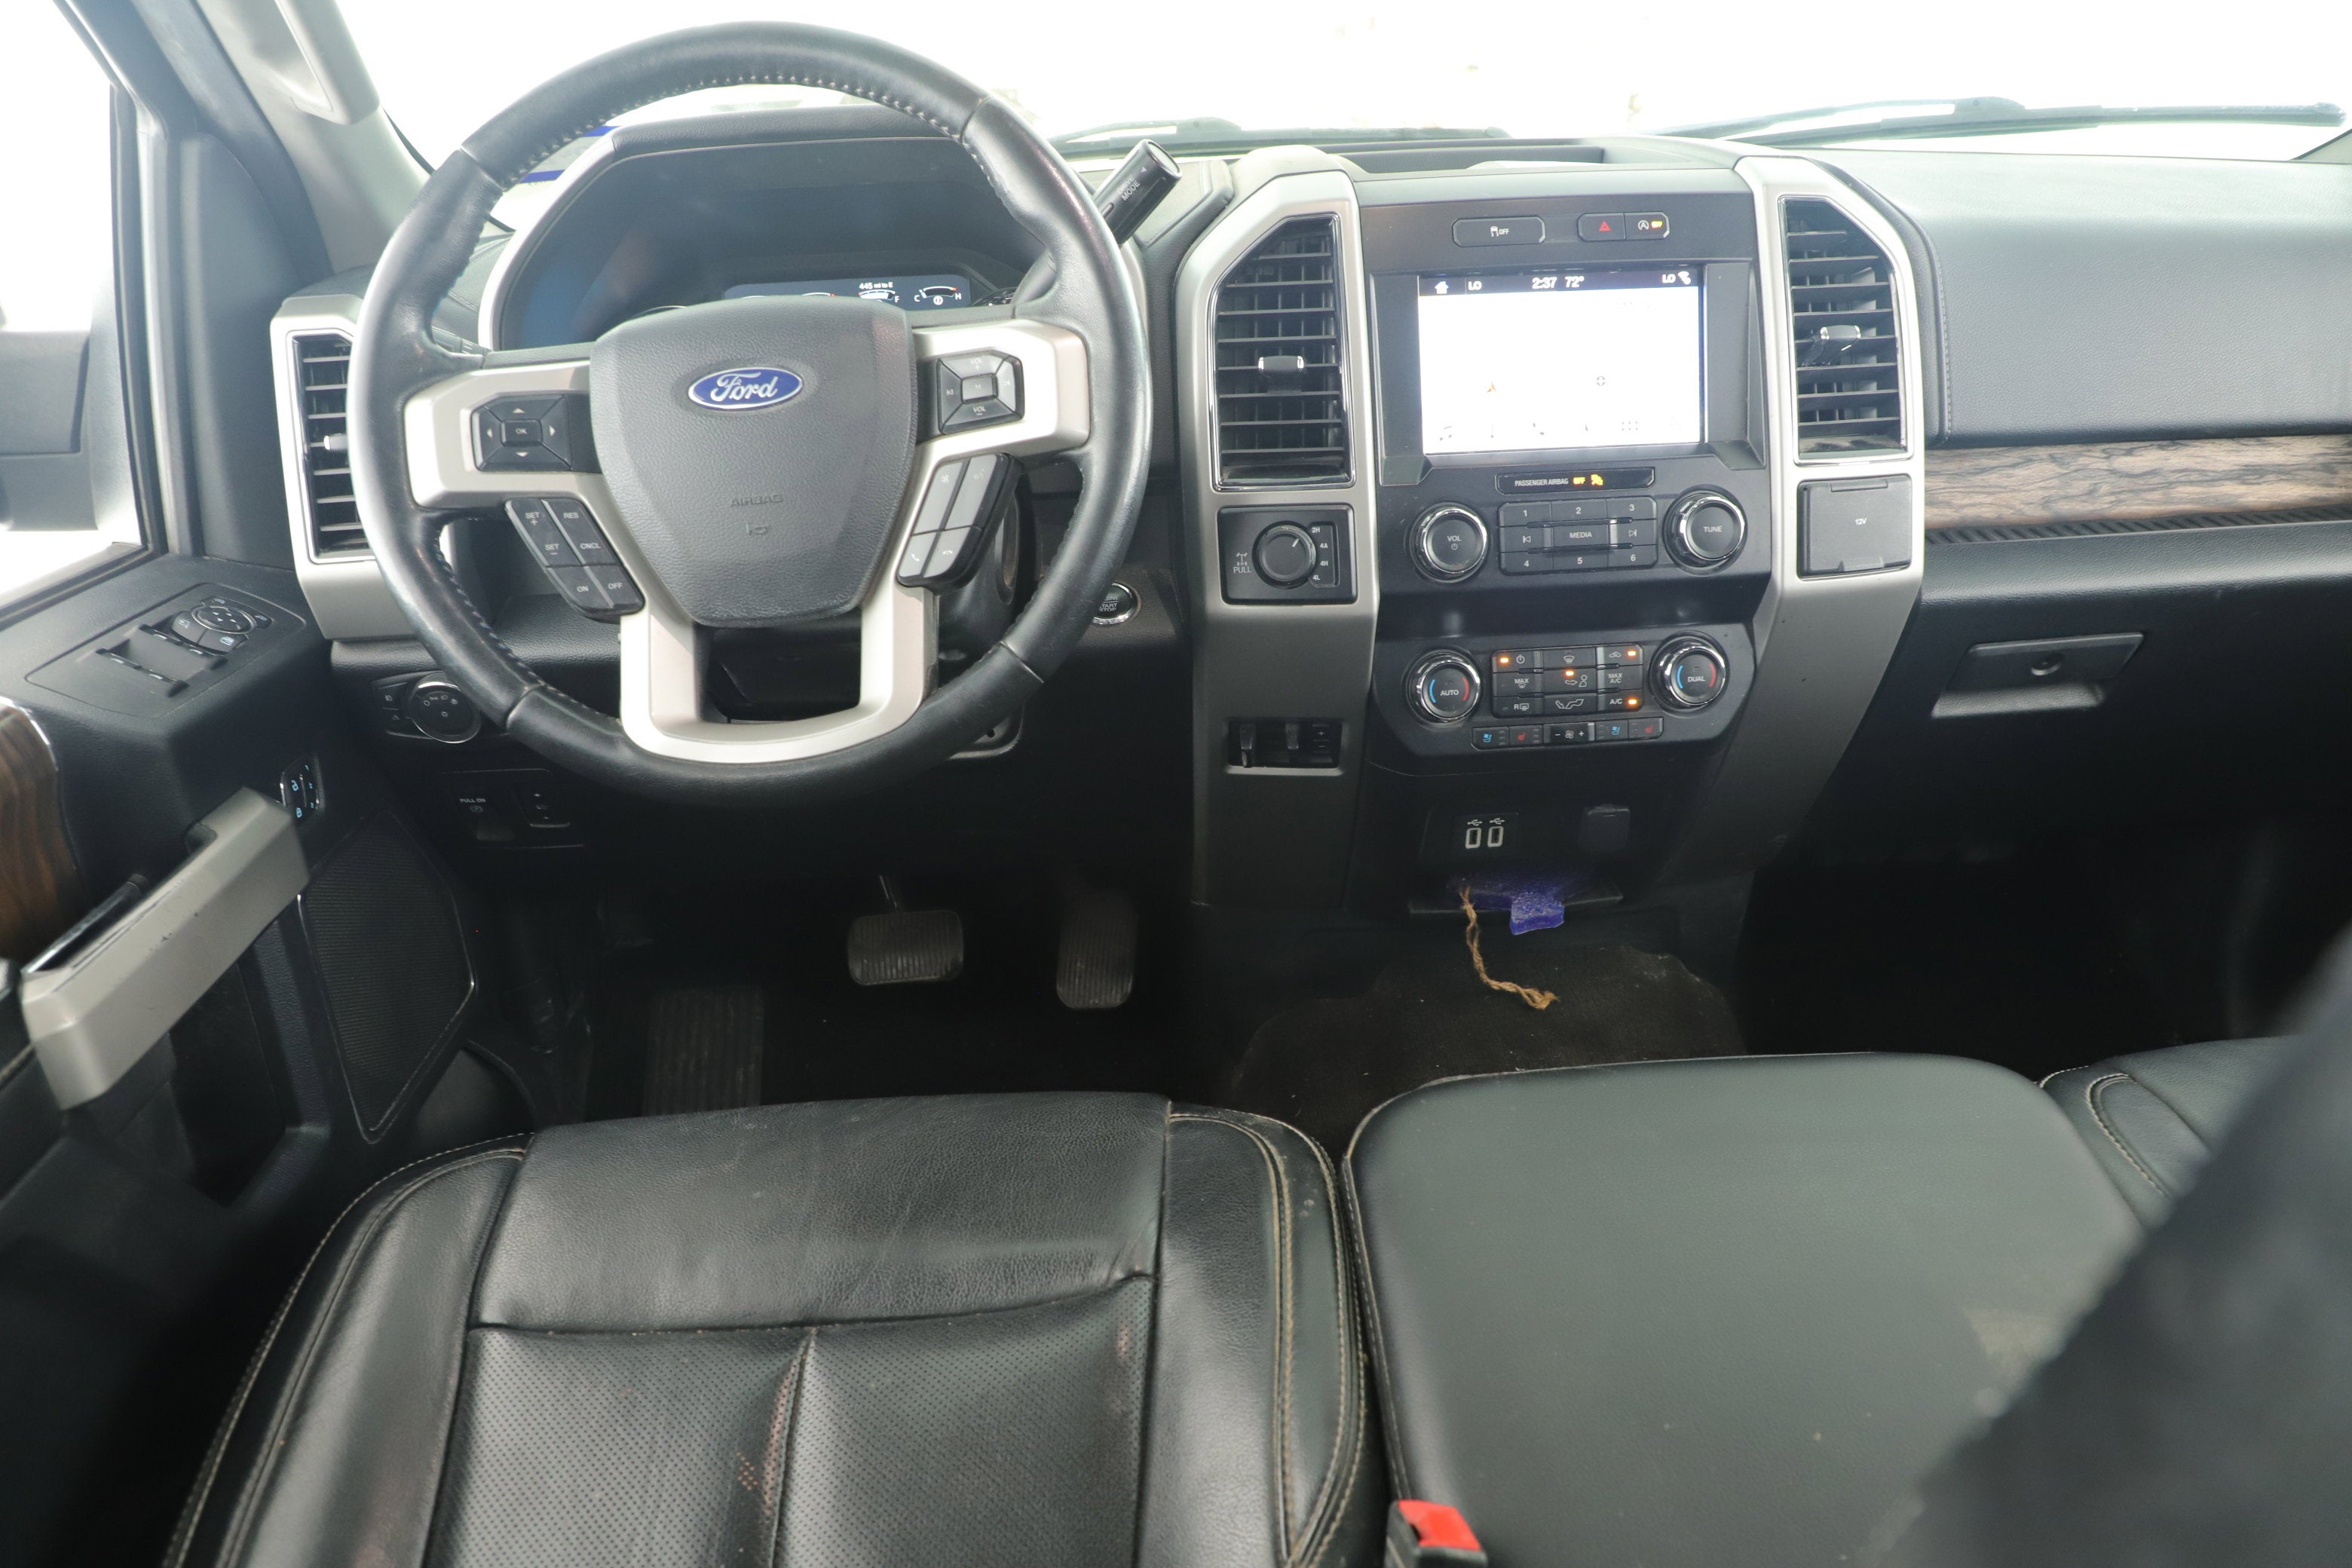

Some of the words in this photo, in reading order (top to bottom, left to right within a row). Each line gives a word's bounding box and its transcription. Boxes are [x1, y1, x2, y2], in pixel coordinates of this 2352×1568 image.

[1121, 179, 1141, 201] MODE
[1532, 277, 1557, 289] 2:37
[1565, 275, 1585, 288] 72°
[1662, 274, 1676, 283] LO
[1468, 280, 1482, 291] LO
[710, 372, 779, 402] Ford
[1514, 479, 1548, 487] PASSENGER
[1548, 477, 1569, 485] AIRBAG
[1629, 504, 1634, 512] 3
[1854, 517, 1867, 525] 12V
[1687, 675, 1706, 683] DUAL
[1440, 688, 1459, 697] AUTO
